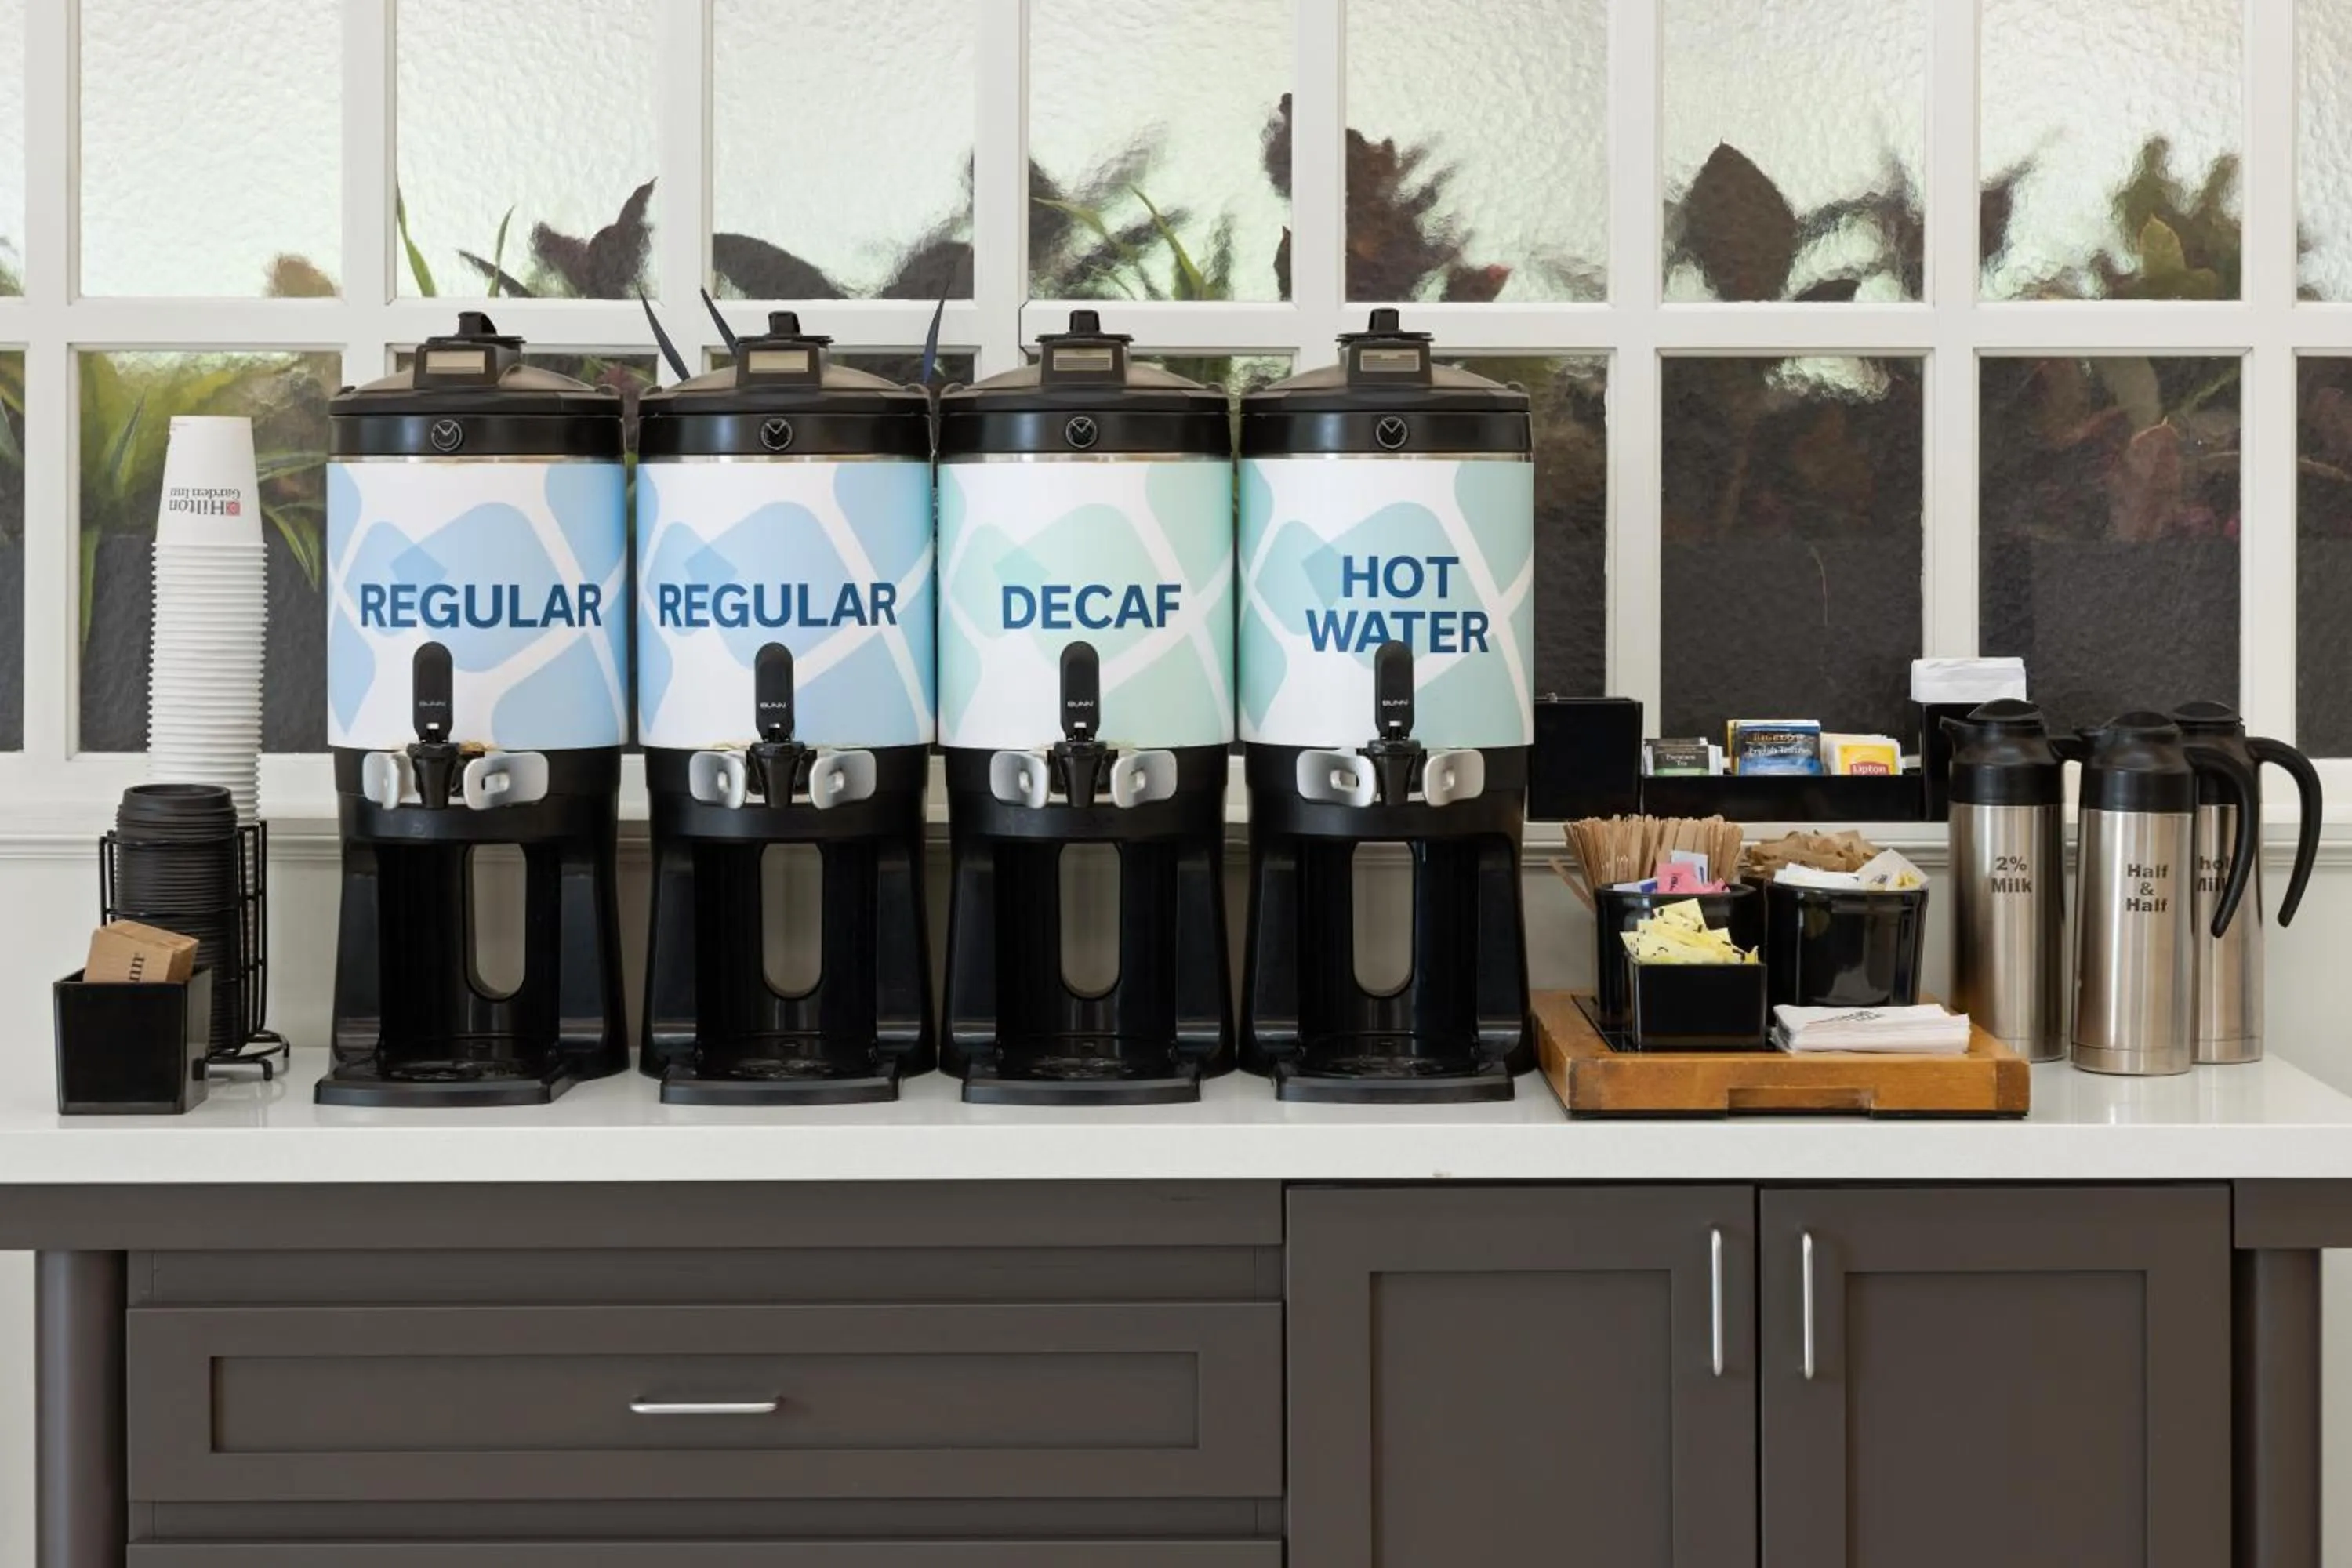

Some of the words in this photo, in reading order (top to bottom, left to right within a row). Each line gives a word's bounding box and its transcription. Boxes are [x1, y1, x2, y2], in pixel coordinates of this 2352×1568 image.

[170, 488, 189, 499] Inn
[192, 488, 241, 499] Garden
[169, 499, 225, 515] Hilton
[1341, 555, 1460, 598] HOT
[360, 583, 602, 628] REGULAR
[659, 582, 897, 627] REGULAR
[1001, 583, 1181, 629] DECAF
[1305, 610, 1490, 653] WATER
[1853, 764, 1886, 775] Lipton
[1995, 855, 2027, 872] 2%
[2198, 855, 2230, 870] hol
[2127, 863, 2169, 879] Half
[1991, 877, 2032, 893] Milk
[2140, 881, 2155, 896] &
[2126, 898, 2169, 913] Half
